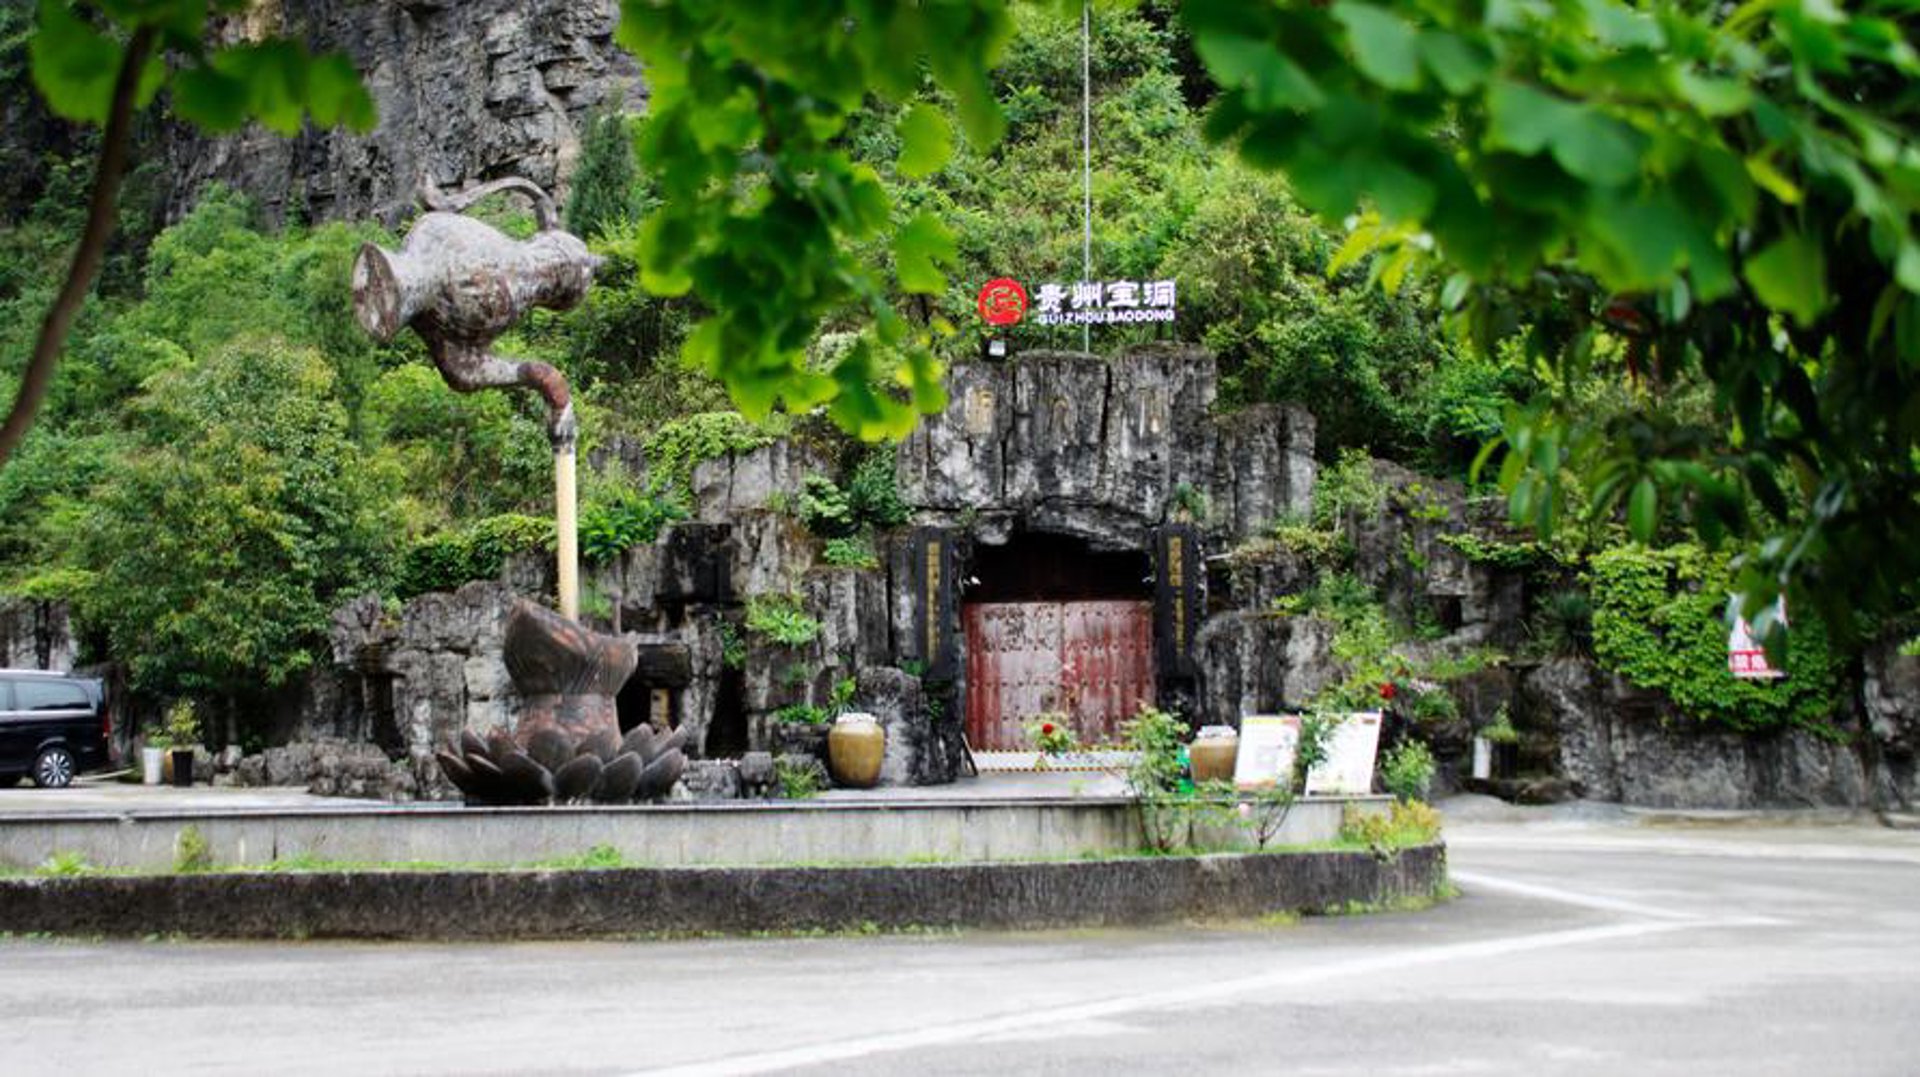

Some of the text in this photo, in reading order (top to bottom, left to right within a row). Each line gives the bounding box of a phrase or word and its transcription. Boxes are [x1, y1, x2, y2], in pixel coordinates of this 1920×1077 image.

[1034, 280, 1175, 313] 贵州宝洞
[1038, 309, 1175, 325] GUIZHOU BAODONG
